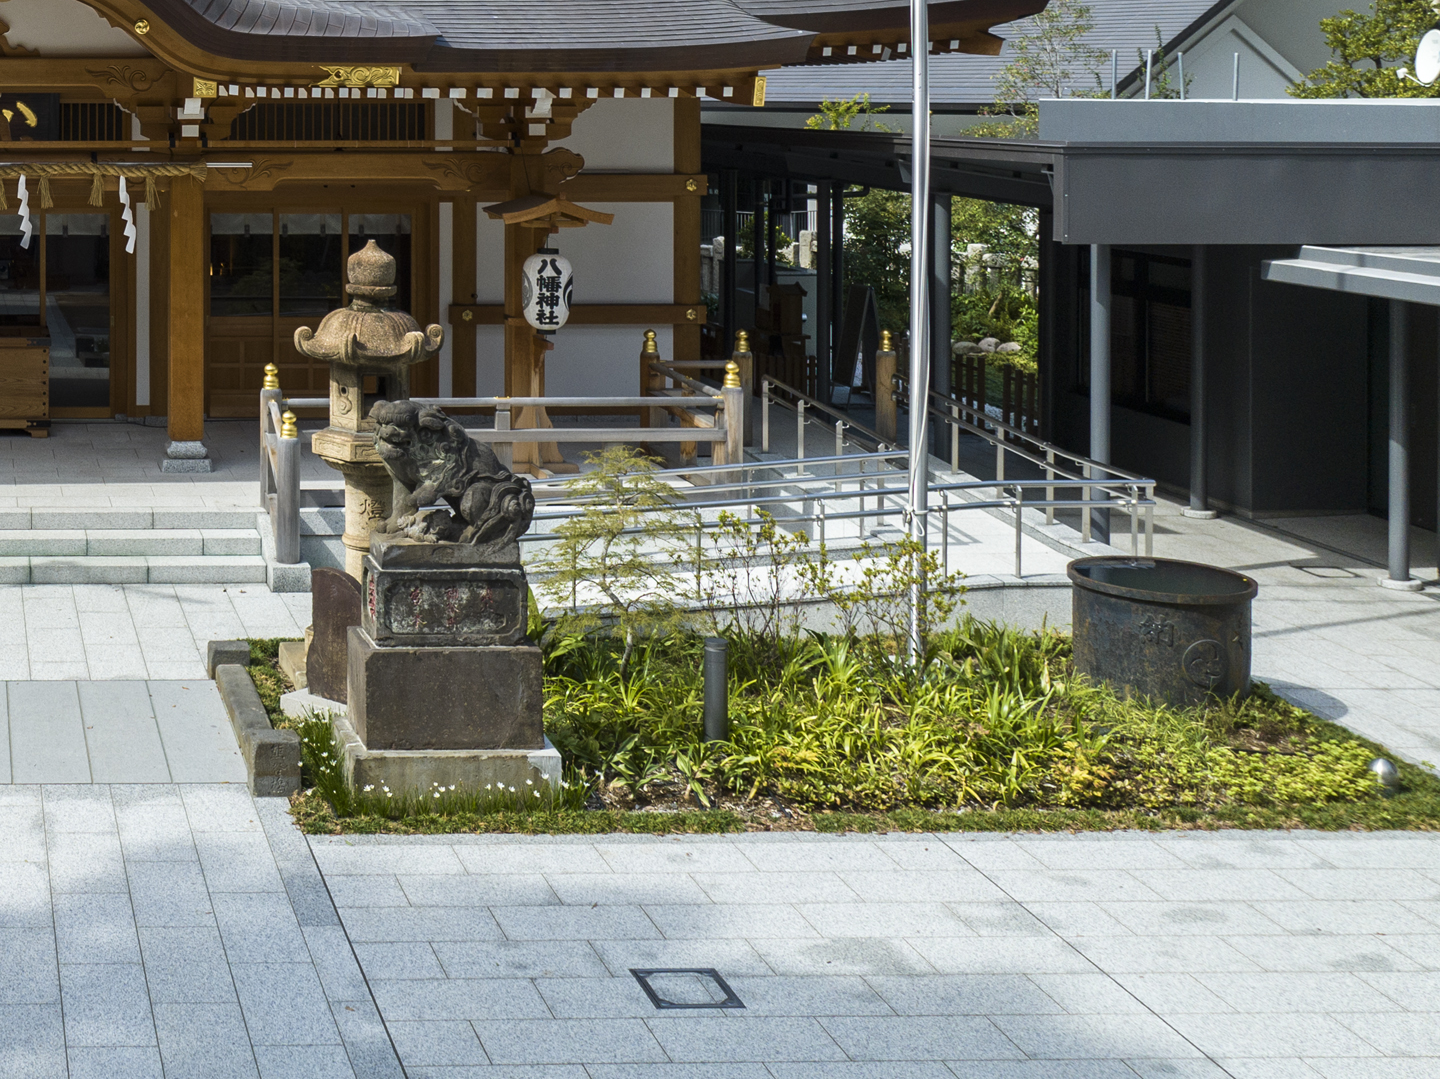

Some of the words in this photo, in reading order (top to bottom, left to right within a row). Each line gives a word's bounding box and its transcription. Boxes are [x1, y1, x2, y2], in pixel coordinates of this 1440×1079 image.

[536, 258, 562, 326] 八幡神社
[360, 499, 387, 521] 燈
